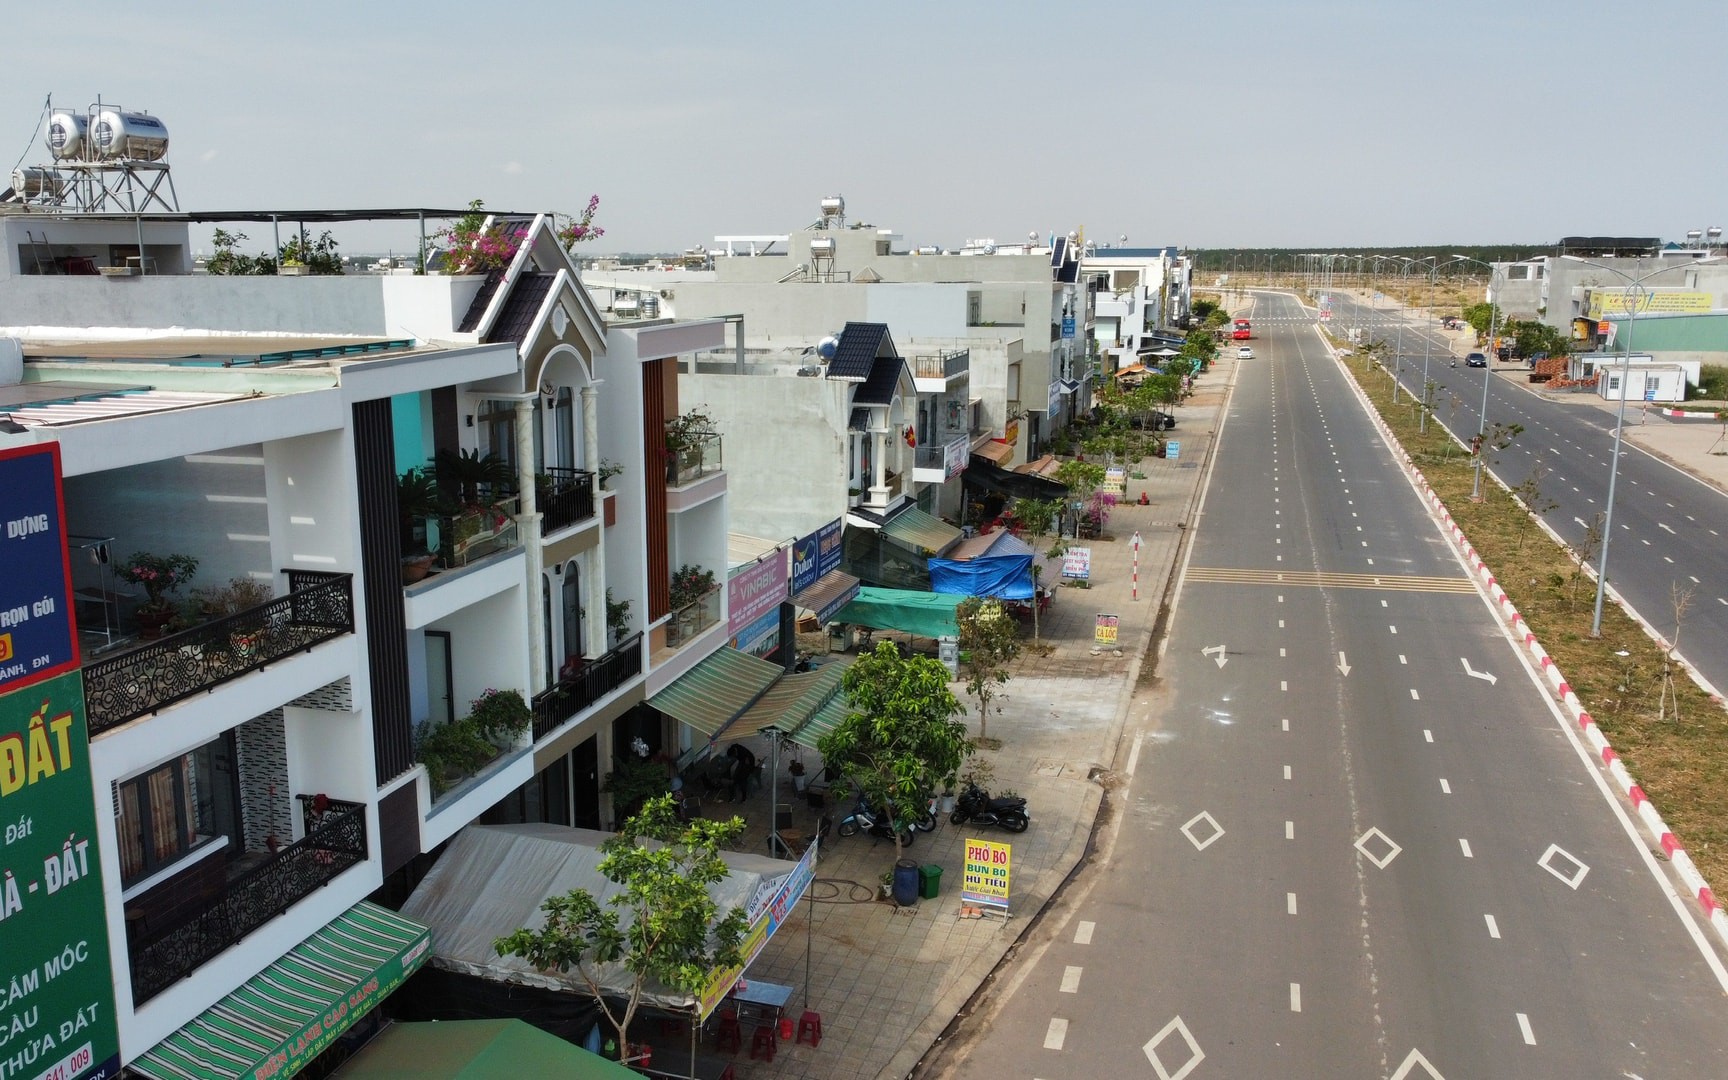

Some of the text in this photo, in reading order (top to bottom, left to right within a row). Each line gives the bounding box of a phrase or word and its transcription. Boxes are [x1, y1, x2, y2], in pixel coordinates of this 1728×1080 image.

[7, 514, 49, 540] DỰNG
[795, 555, 815, 578] Dulux
[740, 567, 777, 600] VINABIC
[32, 595, 55, 618] GÓI
[32, 654, 50, 669] ĐN
[0, 697, 73, 798] ĐẤT
[5, 814, 33, 846] Đất
[44, 832, 88, 895] ĐẤT
[968, 843, 1007, 865] PHỞ BÒ
[44, 940, 88, 983] MỐC
[59, 1002, 99, 1043] ĐẤT
[288, 1022, 323, 1057] LẠNH
[323, 1002, 348, 1029] CAO
[349, 976, 379, 1009] SANG
[70, 1049, 89, 1073] 009
